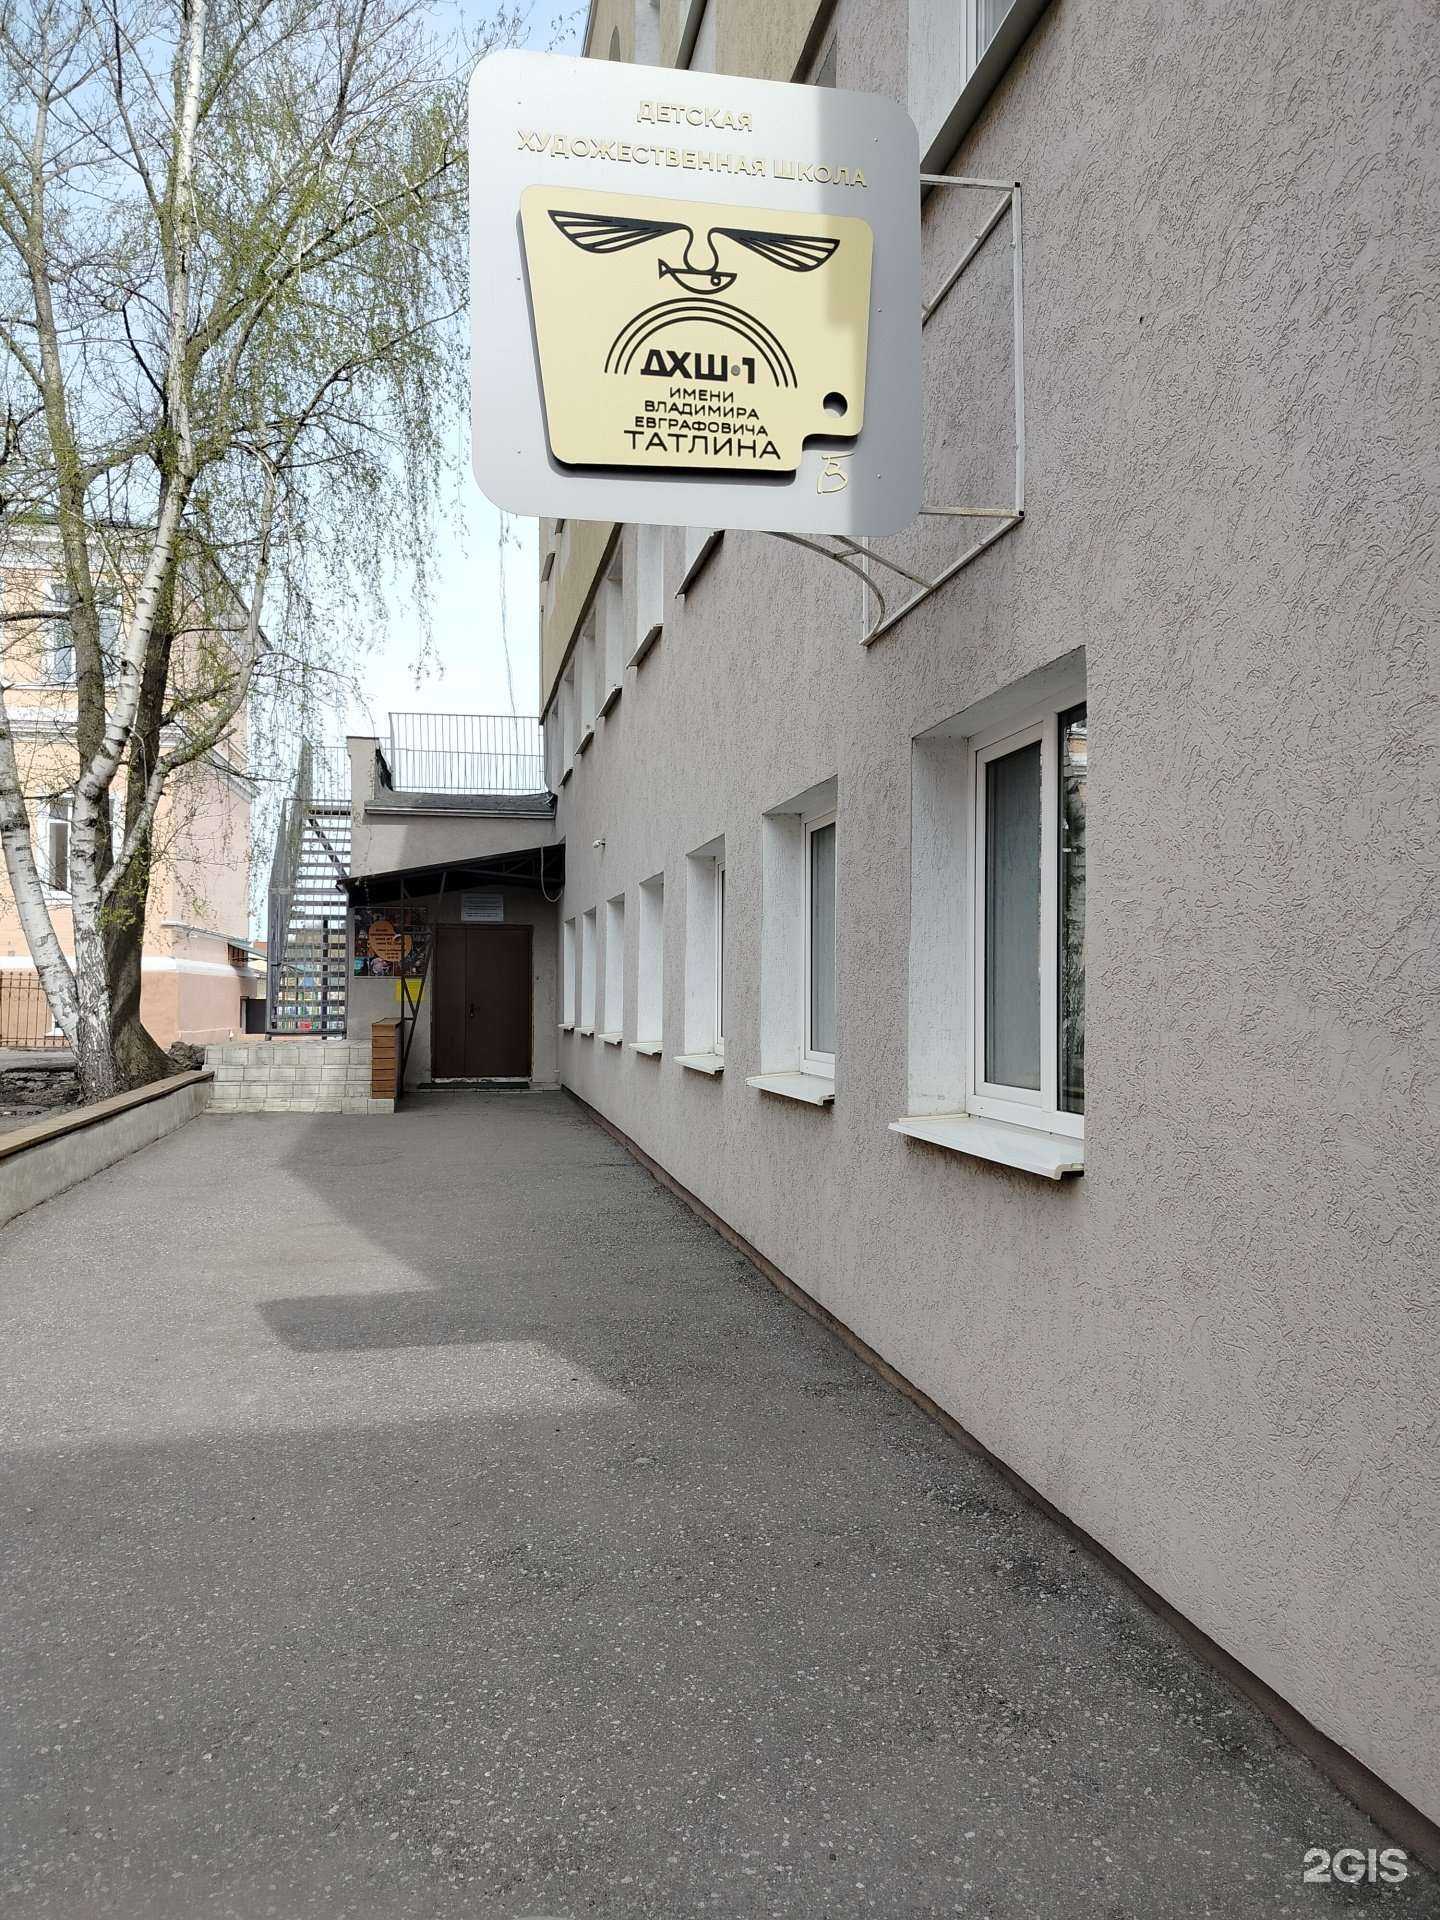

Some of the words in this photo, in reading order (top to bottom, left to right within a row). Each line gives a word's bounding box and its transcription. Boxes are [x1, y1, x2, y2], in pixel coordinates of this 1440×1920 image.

[635, 99, 753, 132] ДЕТСКАЯ
[516, 129, 768, 177] ХУДОЖЕСТВЕННАЯ
[772, 159, 868, 188] ШКОЛА
[669, 387, 734, 403] ИМЕНИ
[644, 400, 760, 421] ВЛАДИМИРА
[634, 416, 769, 437] ЕВГРАФОВИЧА
[623, 430, 781, 460] ТАТЛИНА
